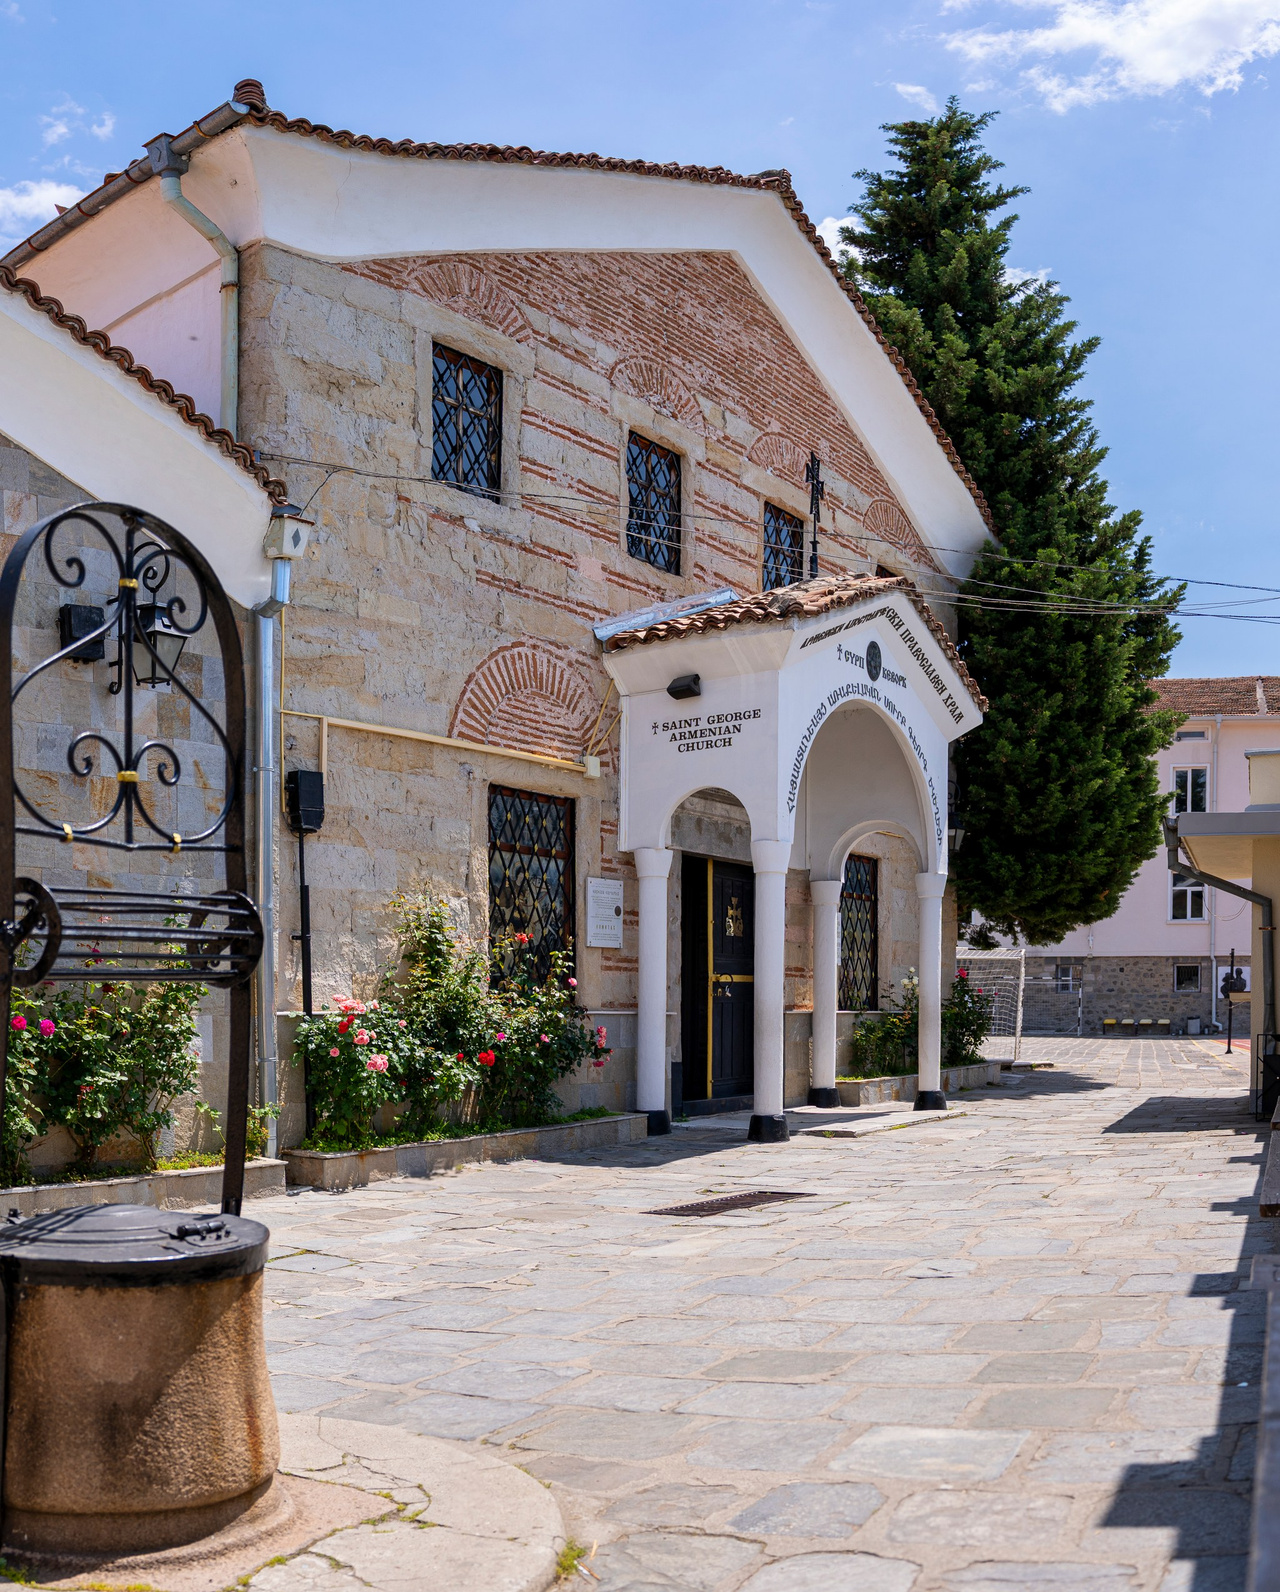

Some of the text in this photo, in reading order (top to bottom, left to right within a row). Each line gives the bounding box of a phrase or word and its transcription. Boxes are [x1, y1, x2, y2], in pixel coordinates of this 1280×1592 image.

[844, 649, 907, 689] СУРП КЕВОРК
[899, 628, 948, 696] ПРАВОСЛАВЕН
[942, 693, 965, 725] ХРАМ
[662, 708, 761, 732] SAINT GEORGE
[669, 723, 742, 742] ARMENIAN
[677, 737, 733, 753] CHURCH
